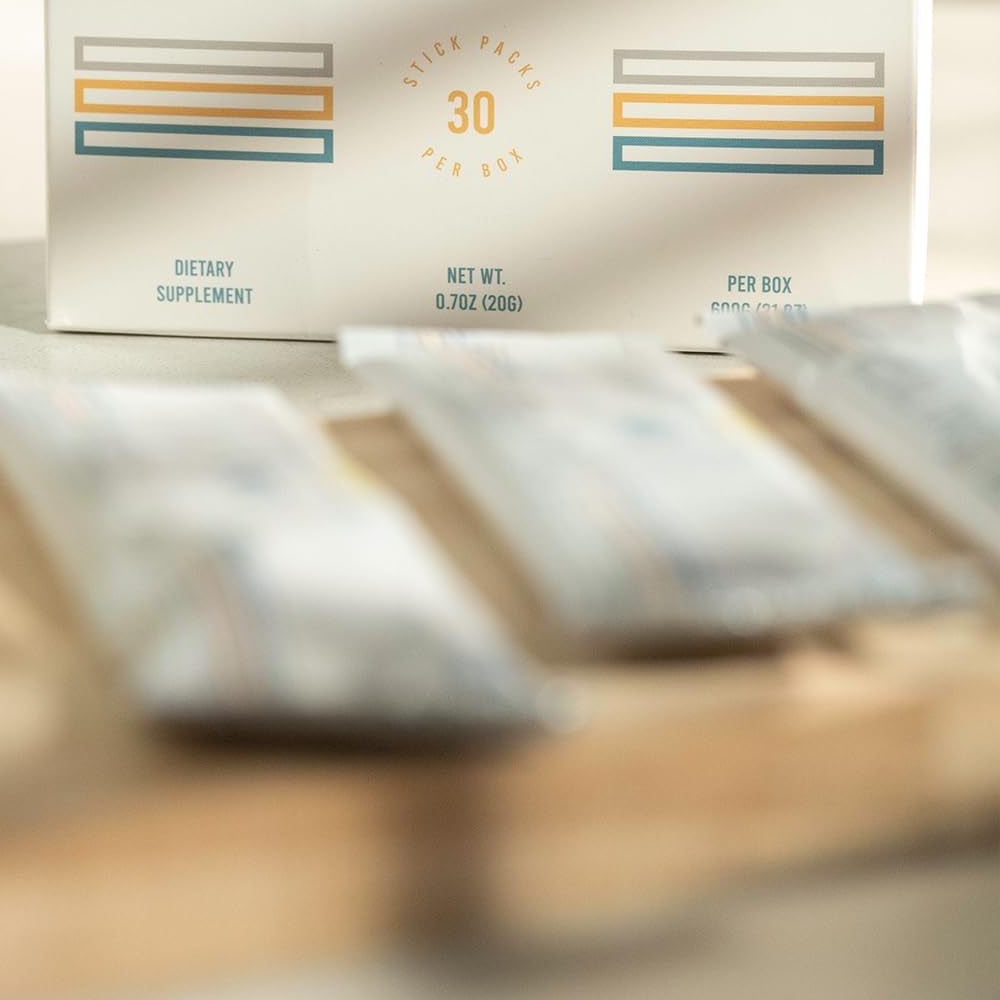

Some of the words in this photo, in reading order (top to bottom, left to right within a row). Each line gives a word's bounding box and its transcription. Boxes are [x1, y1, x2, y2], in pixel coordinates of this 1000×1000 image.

[403, 36, 461, 87] STICK
[480, 36, 541, 90] PACKS
[448, 90, 494, 134] 30
[422, 147, 461, 176] PER
[481, 149, 523, 177] BOX
[175, 260, 234, 277] DIETARY
[448, 267, 475, 284] NET
[480, 268, 505, 285] WT.
[728, 275, 755, 292] PER
[762, 276, 791, 293] BOX
[157, 285, 252, 304] SUPPLEMENT
[482, 295, 522, 312] (20G)
